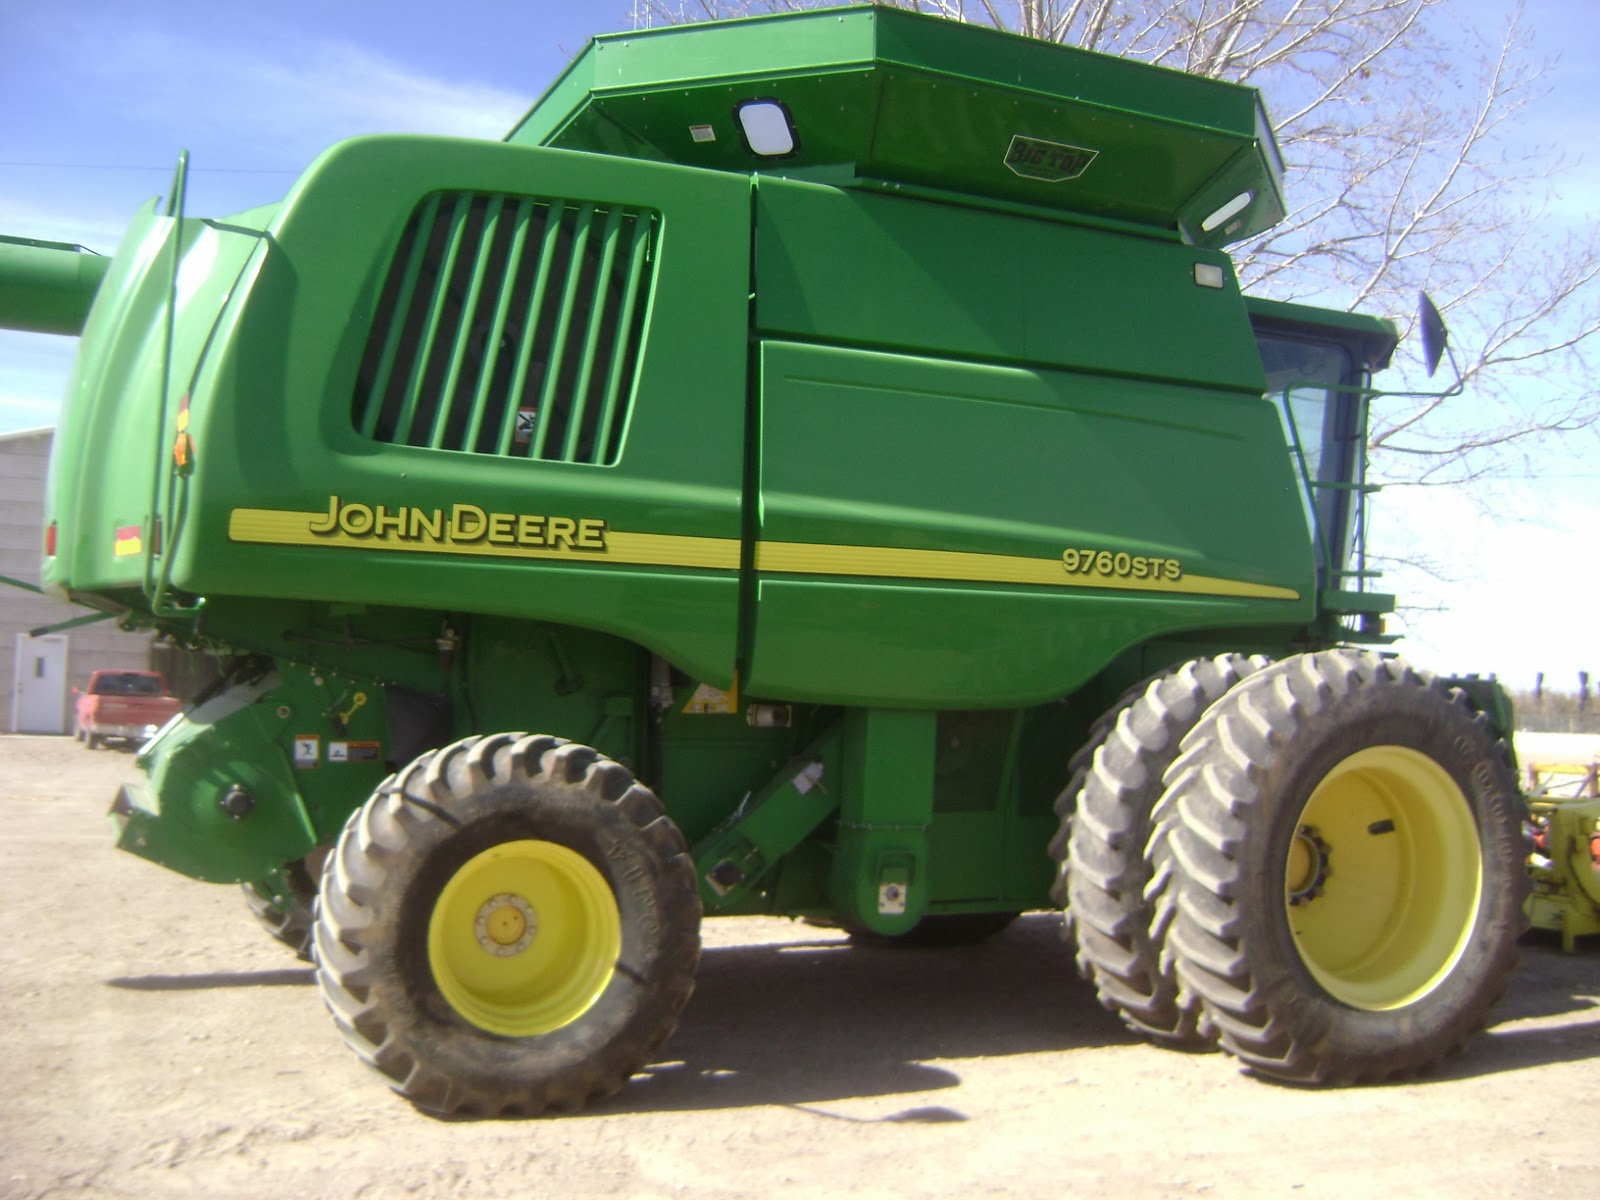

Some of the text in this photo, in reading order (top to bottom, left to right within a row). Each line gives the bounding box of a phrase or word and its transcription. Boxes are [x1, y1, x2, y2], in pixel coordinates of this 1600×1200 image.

[309, 495, 607, 551] JOHN DEERE
[1062, 548, 1182, 580] 9760STS
